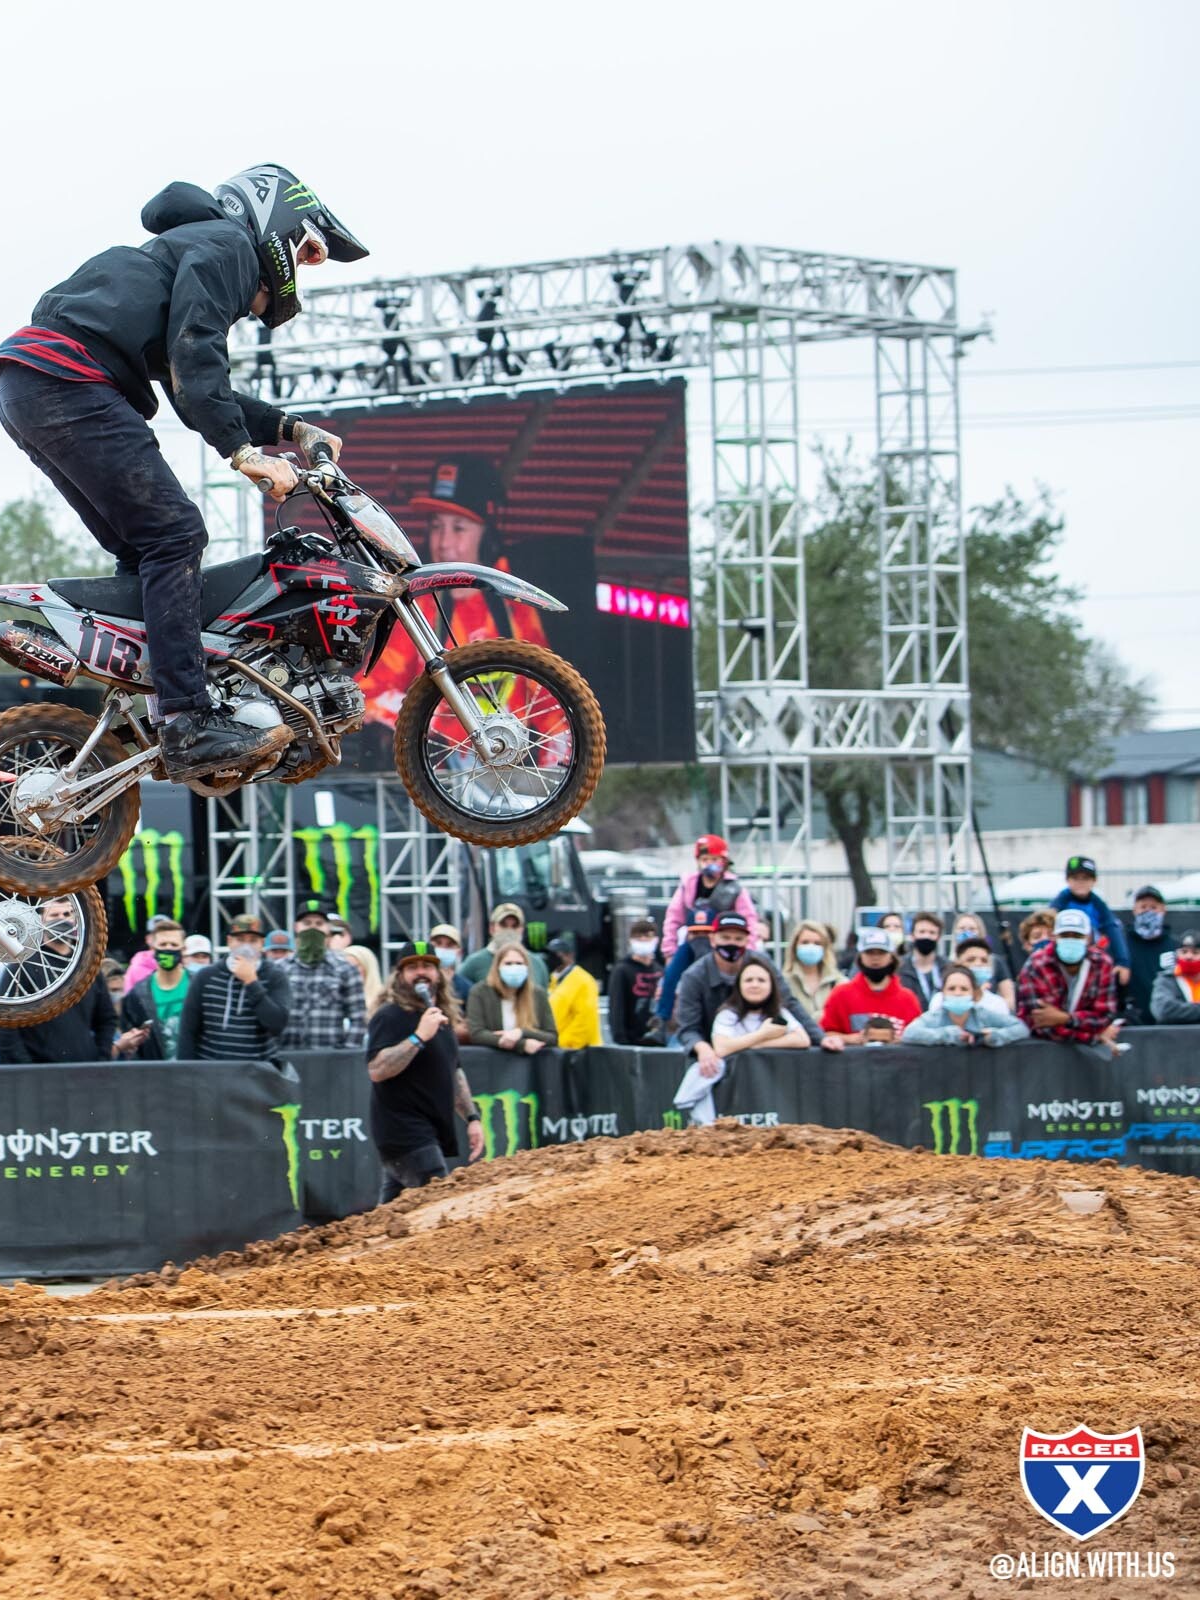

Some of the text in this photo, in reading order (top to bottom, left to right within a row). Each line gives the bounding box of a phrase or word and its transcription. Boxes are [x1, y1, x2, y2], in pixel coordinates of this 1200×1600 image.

[270, 231, 291, 281] MONSTER
[19, 640, 65, 669] DBK
[79, 625, 142, 680] 113
[4, 1165, 130, 1179] ENERGY
